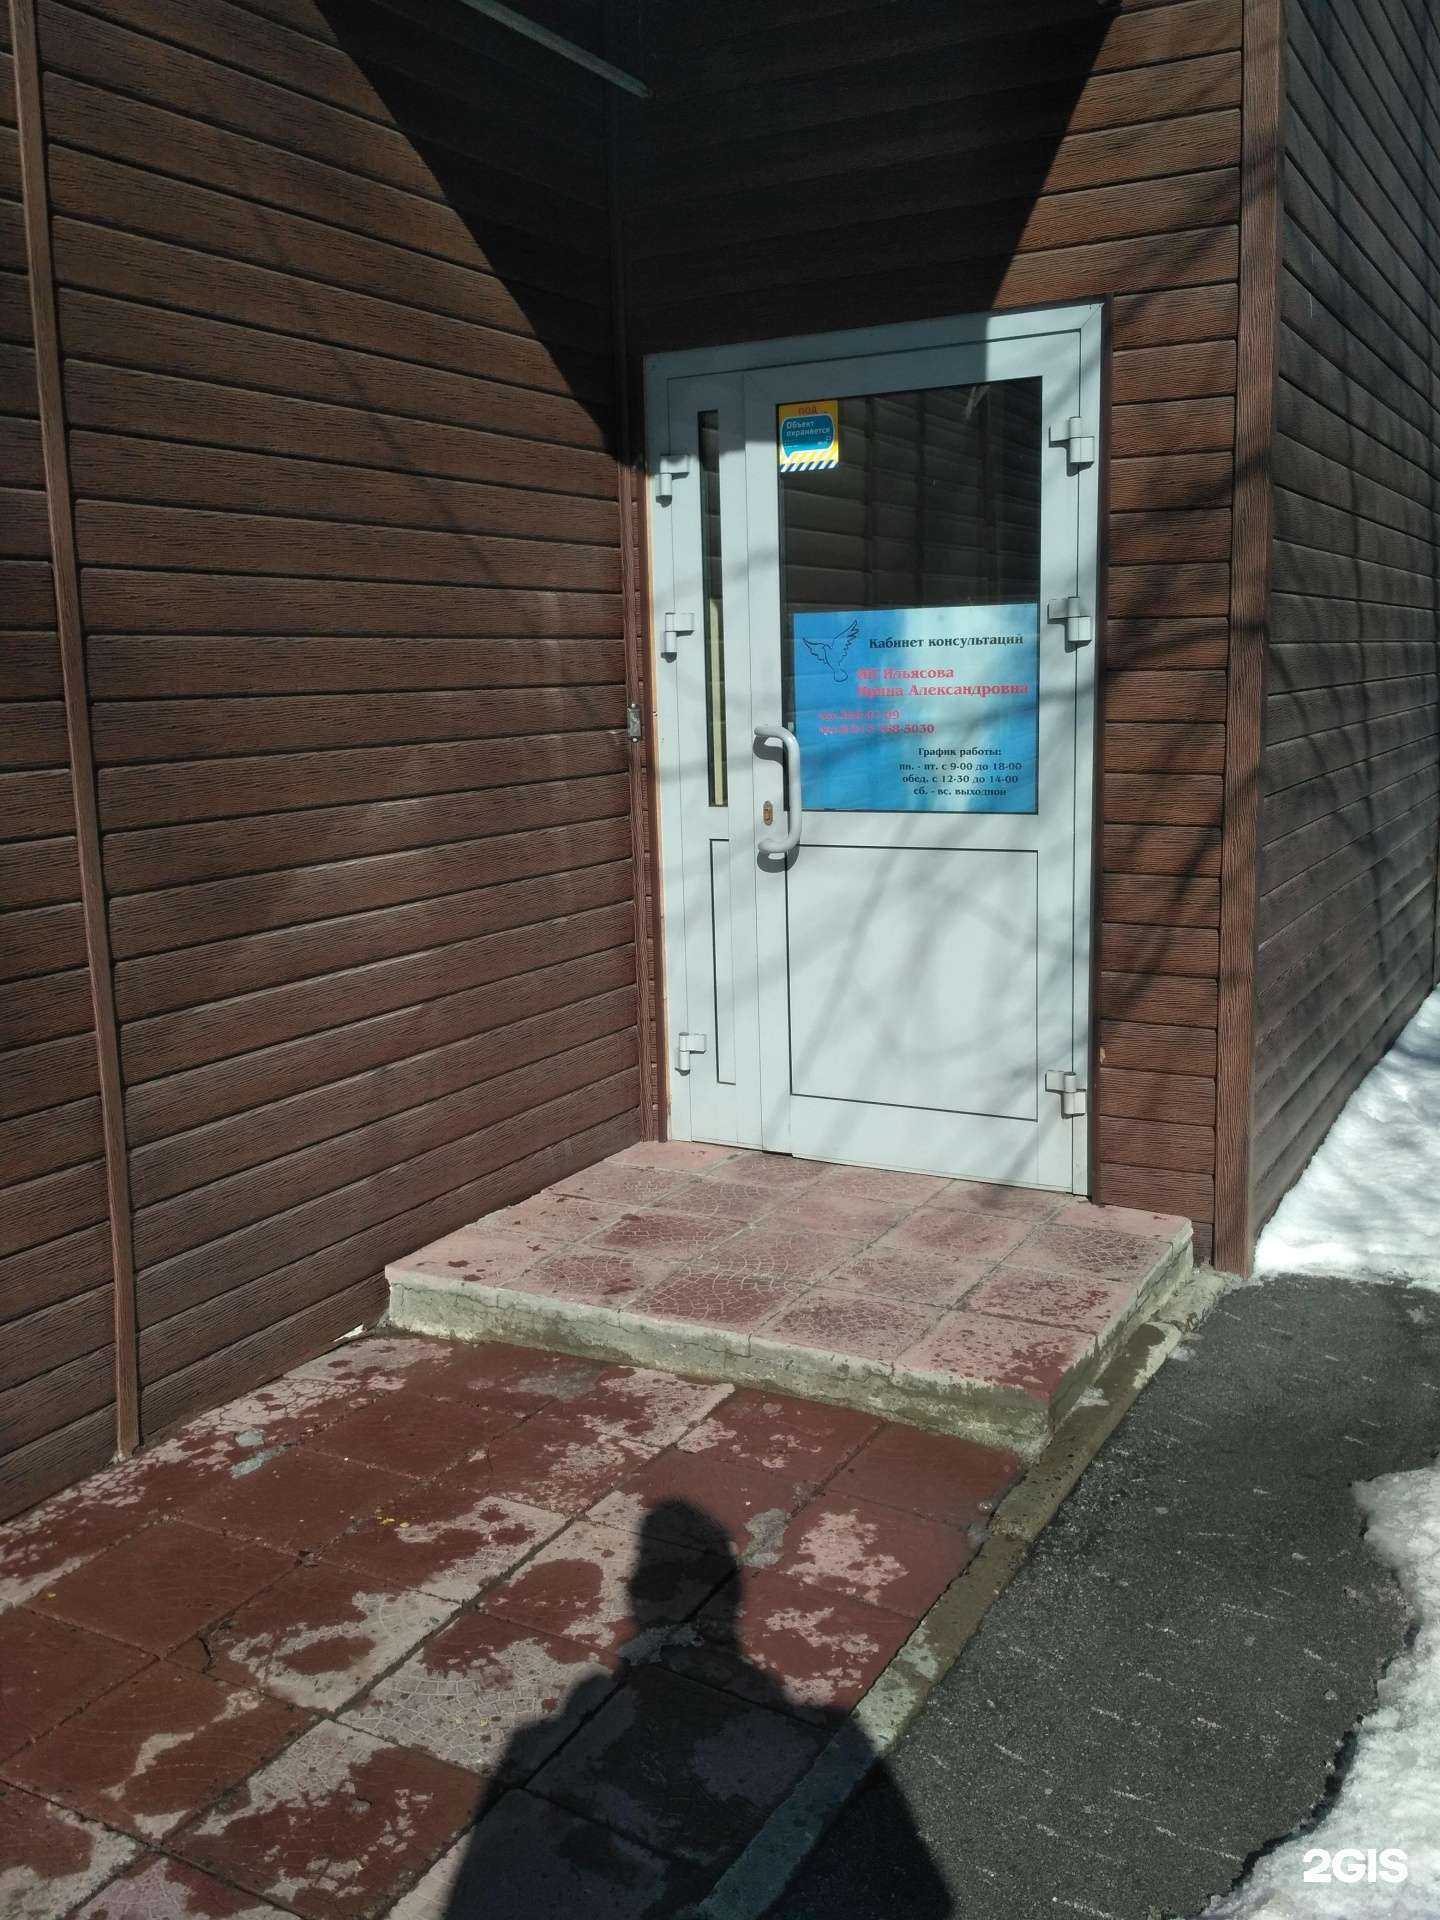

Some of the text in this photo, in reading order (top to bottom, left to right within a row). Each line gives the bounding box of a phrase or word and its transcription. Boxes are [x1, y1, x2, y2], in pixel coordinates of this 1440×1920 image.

[786, 421, 815, 429] Объект
[786, 428, 831, 437] охраняется
[869, 634, 1024, 649] Кабинет консультаций
[883, 667, 955, 680] Ильясова
[909, 682, 1029, 699] Александровна
[918, 747, 1002, 758] График работы:
[899, 763, 914, 771] пн.
[924, 763, 938, 771] пт.
[941, 763, 948, 771] с
[950, 762, 973, 771] 9-00
[975, 763, 989, 772] до
[992, 762, 1023, 771] 18-00
[902, 775, 929, 784] обед.
[942, 775, 970, 783] 12-30
[973, 776, 986, 784] до
[990, 775, 1019, 783] 14-00
[913, 787, 928, 796] сб.
[937, 788, 952, 796] вс.
